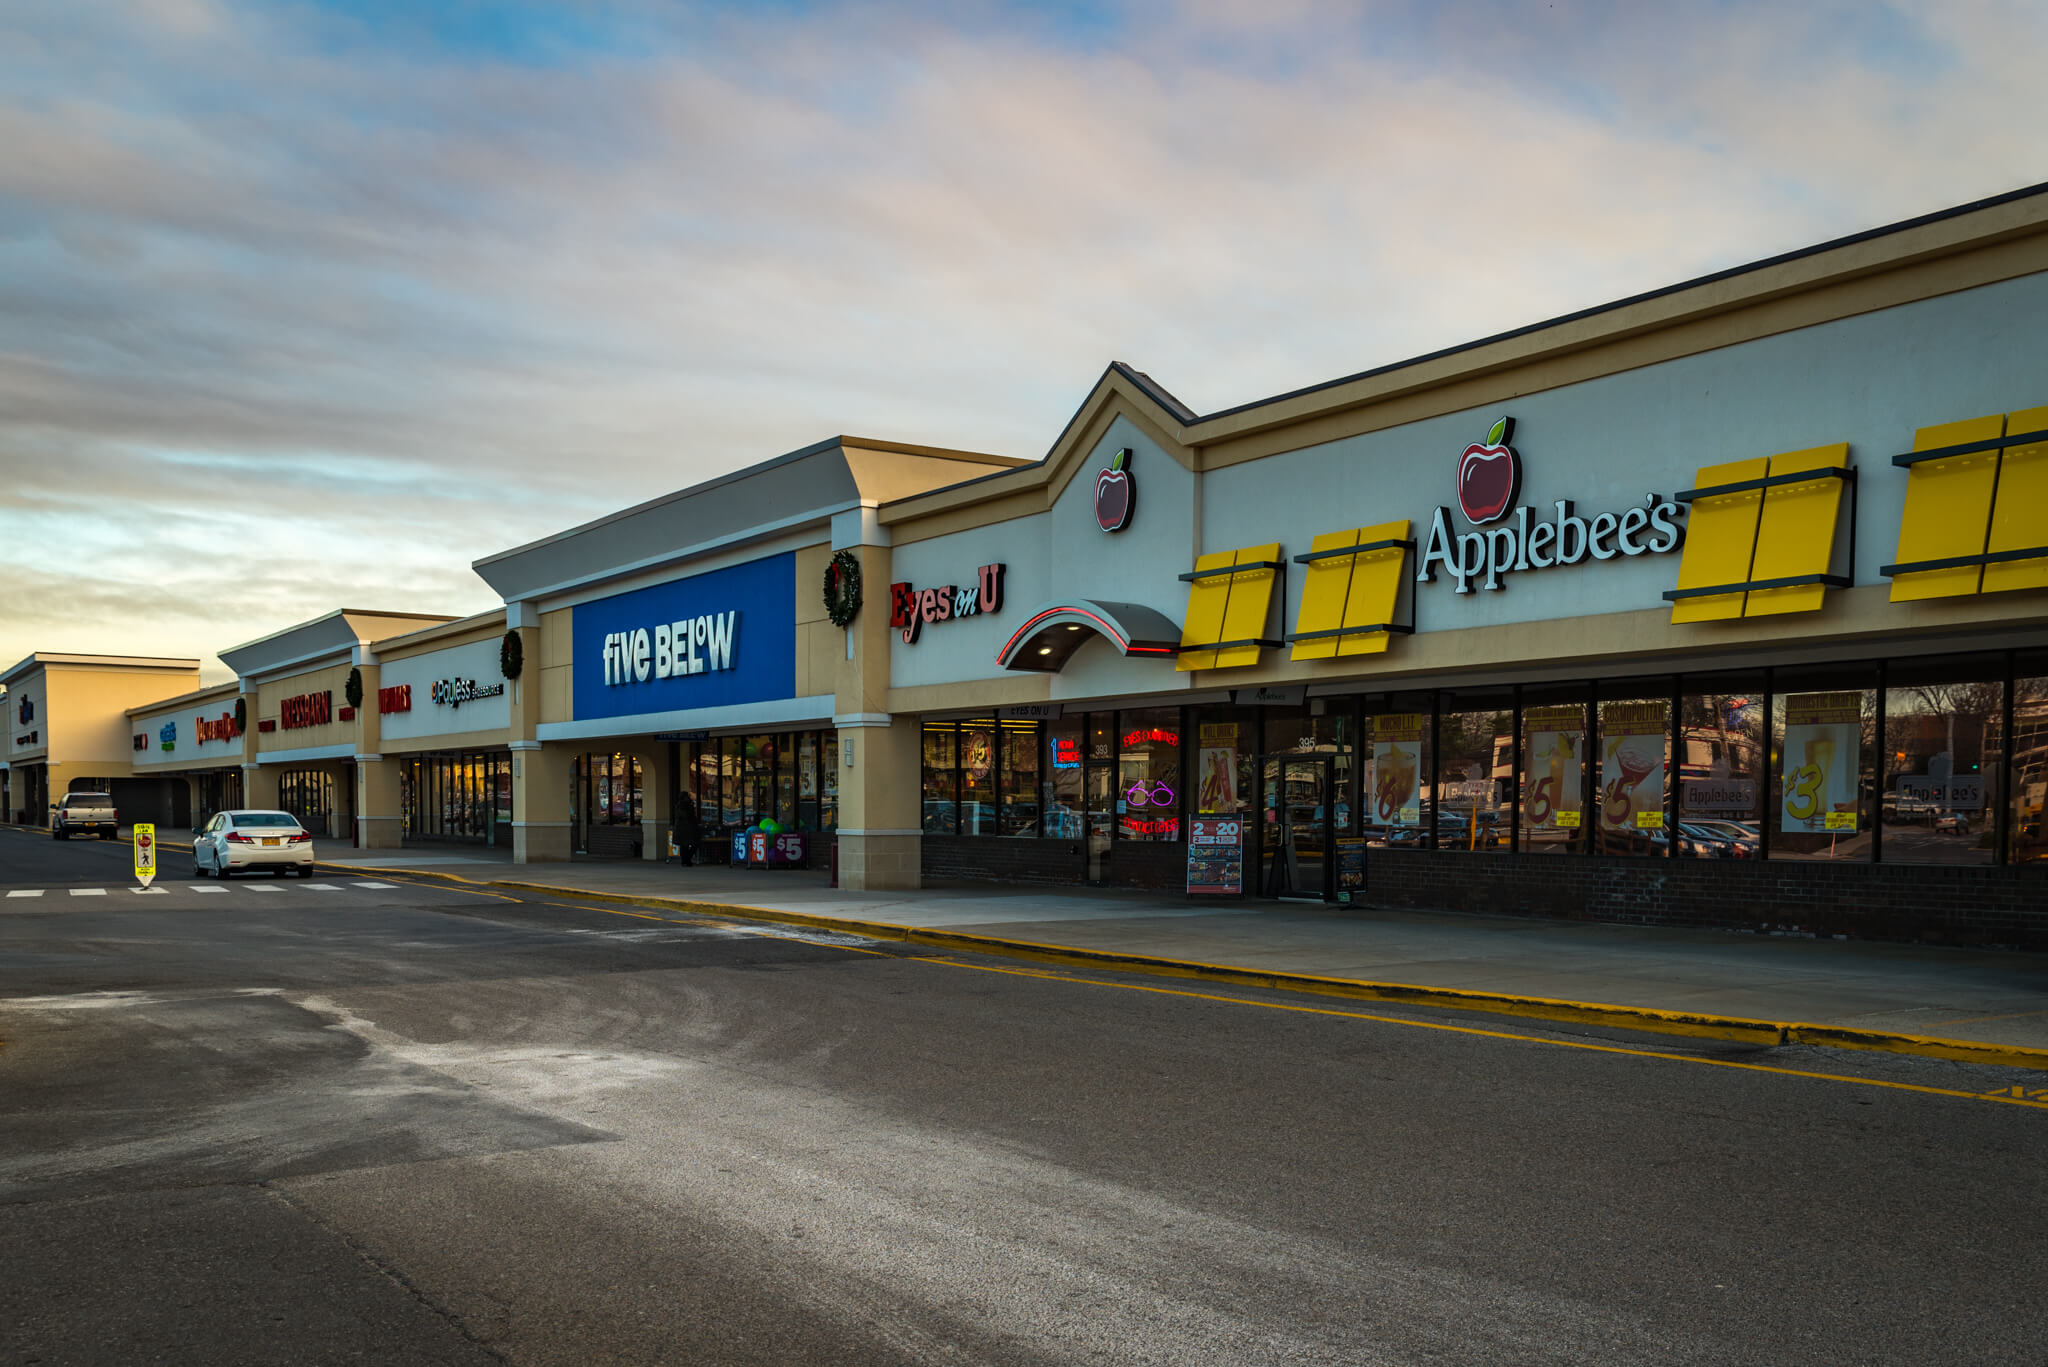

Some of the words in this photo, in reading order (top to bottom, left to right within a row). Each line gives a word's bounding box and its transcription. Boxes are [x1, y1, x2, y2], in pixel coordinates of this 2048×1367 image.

[1416, 493, 1685, 594] Applebee's
[889, 582, 957, 645] Eyes
[954, 588, 980, 618] on
[978, 563, 1006, 613] U
[603, 627, 651, 686] five
[655, 610, 737, 679] BELOW
[438, 679, 474, 707] Payless
[281, 691, 331, 730] DRESSBARN
[1604, 703, 1665, 721] COSMOPOLITAN
[1095, 744, 1108, 755] 393
[1299, 737, 1316, 749] 395
[733, 837, 747, 860] $5
[752, 838, 765, 861] $5
[776, 837, 803, 861] $5
